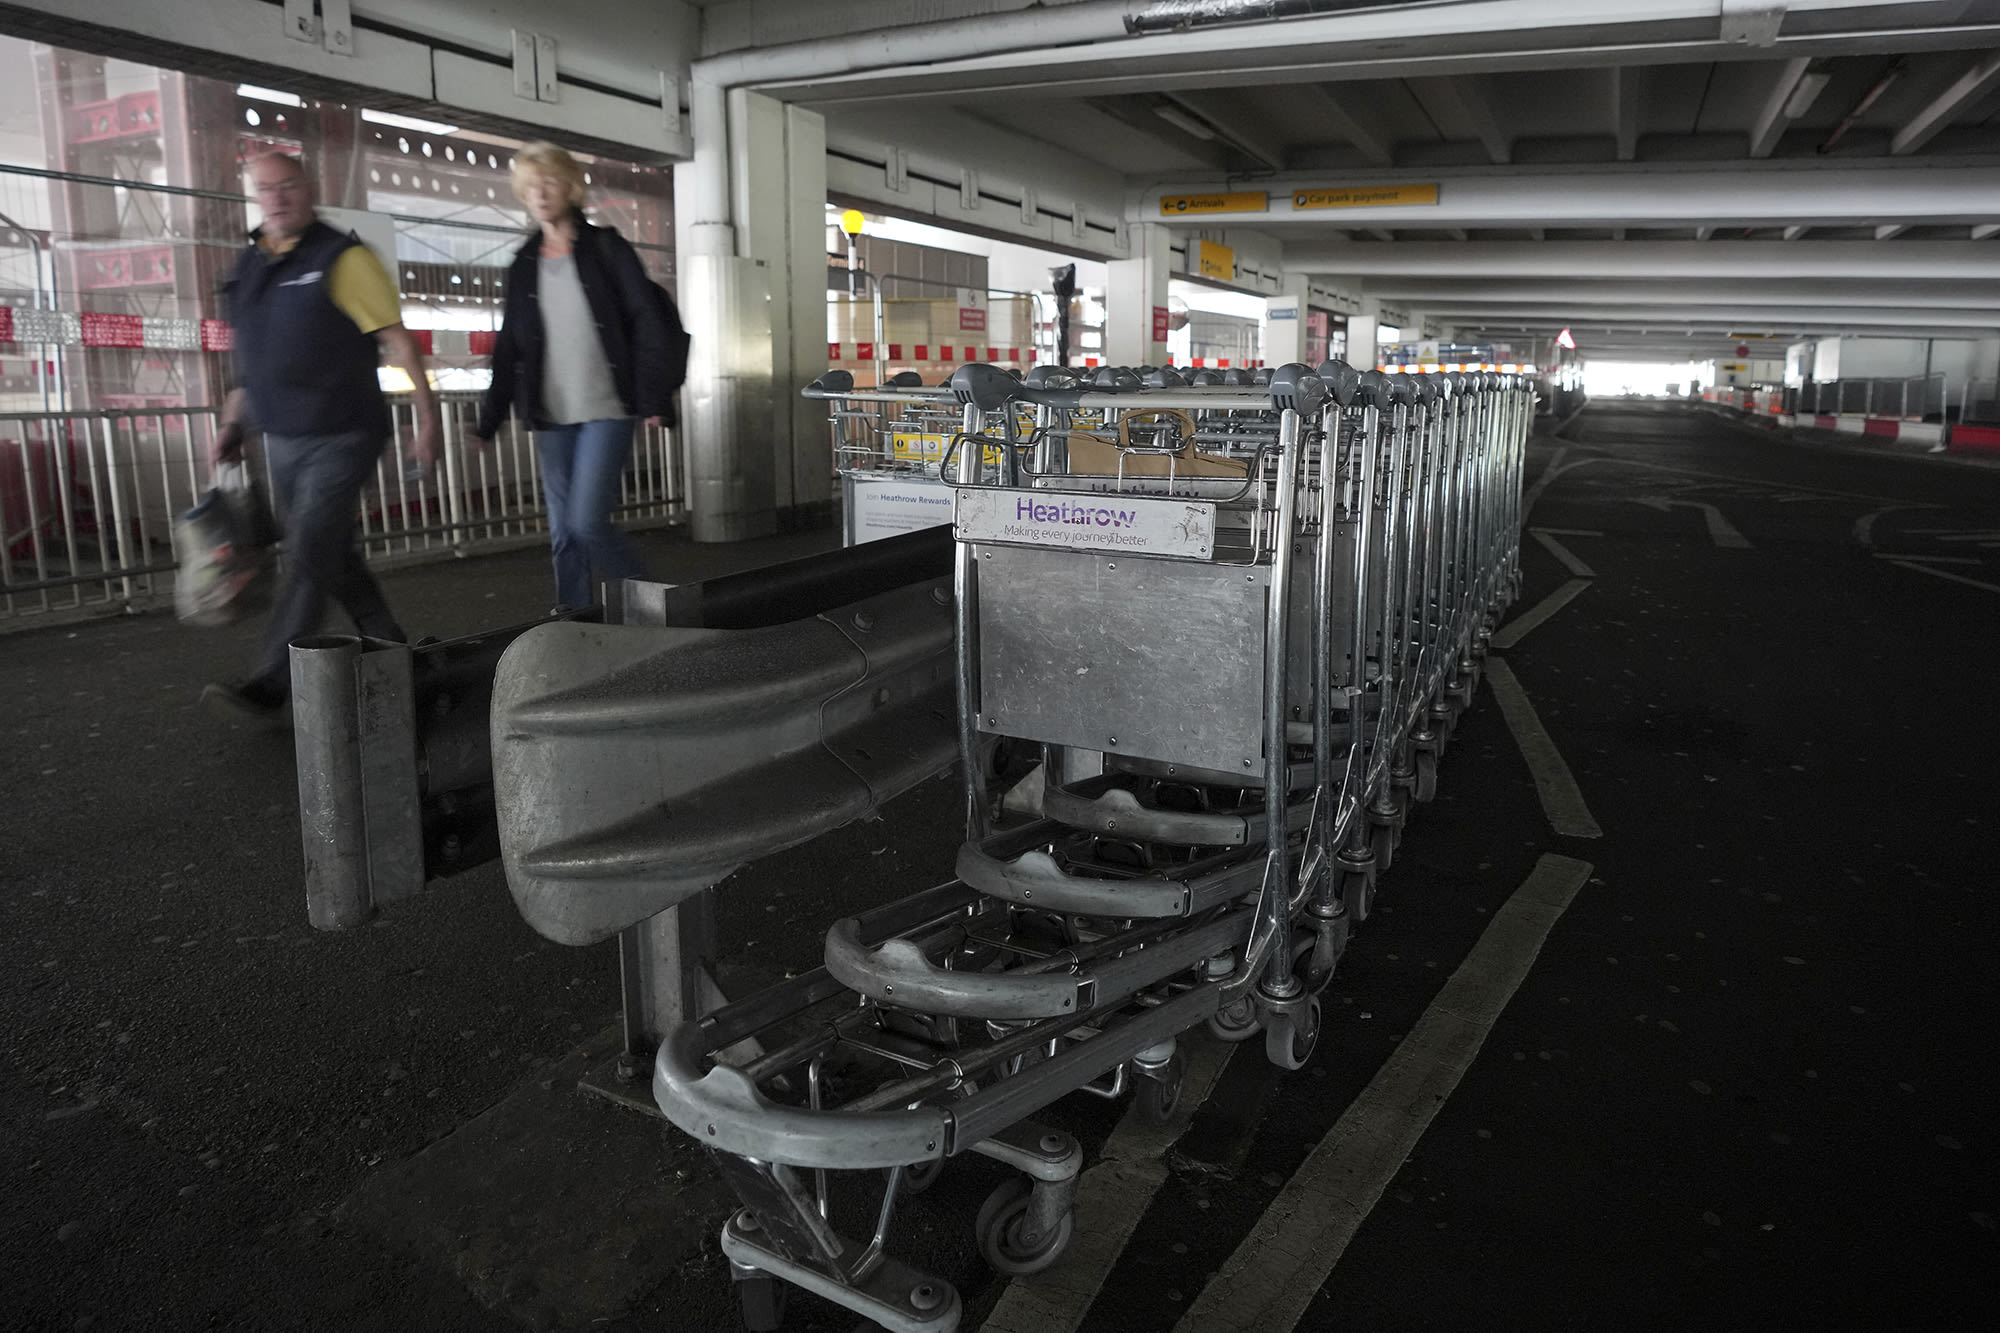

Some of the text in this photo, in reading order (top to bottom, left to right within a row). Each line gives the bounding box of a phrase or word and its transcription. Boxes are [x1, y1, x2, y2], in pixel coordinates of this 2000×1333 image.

[1189, 199, 1225, 208] Arrivals
[1309, 194, 1325, 203] Car
[1328, 193, 1349, 204] park
[1353, 191, 1400, 204] payment
[880, 494, 917, 503] Heathrow
[918, 496, 951, 505] Rewards
[1017, 497, 1136, 528] Heathrow
[1004, 525, 1148, 546] Making every journey better
